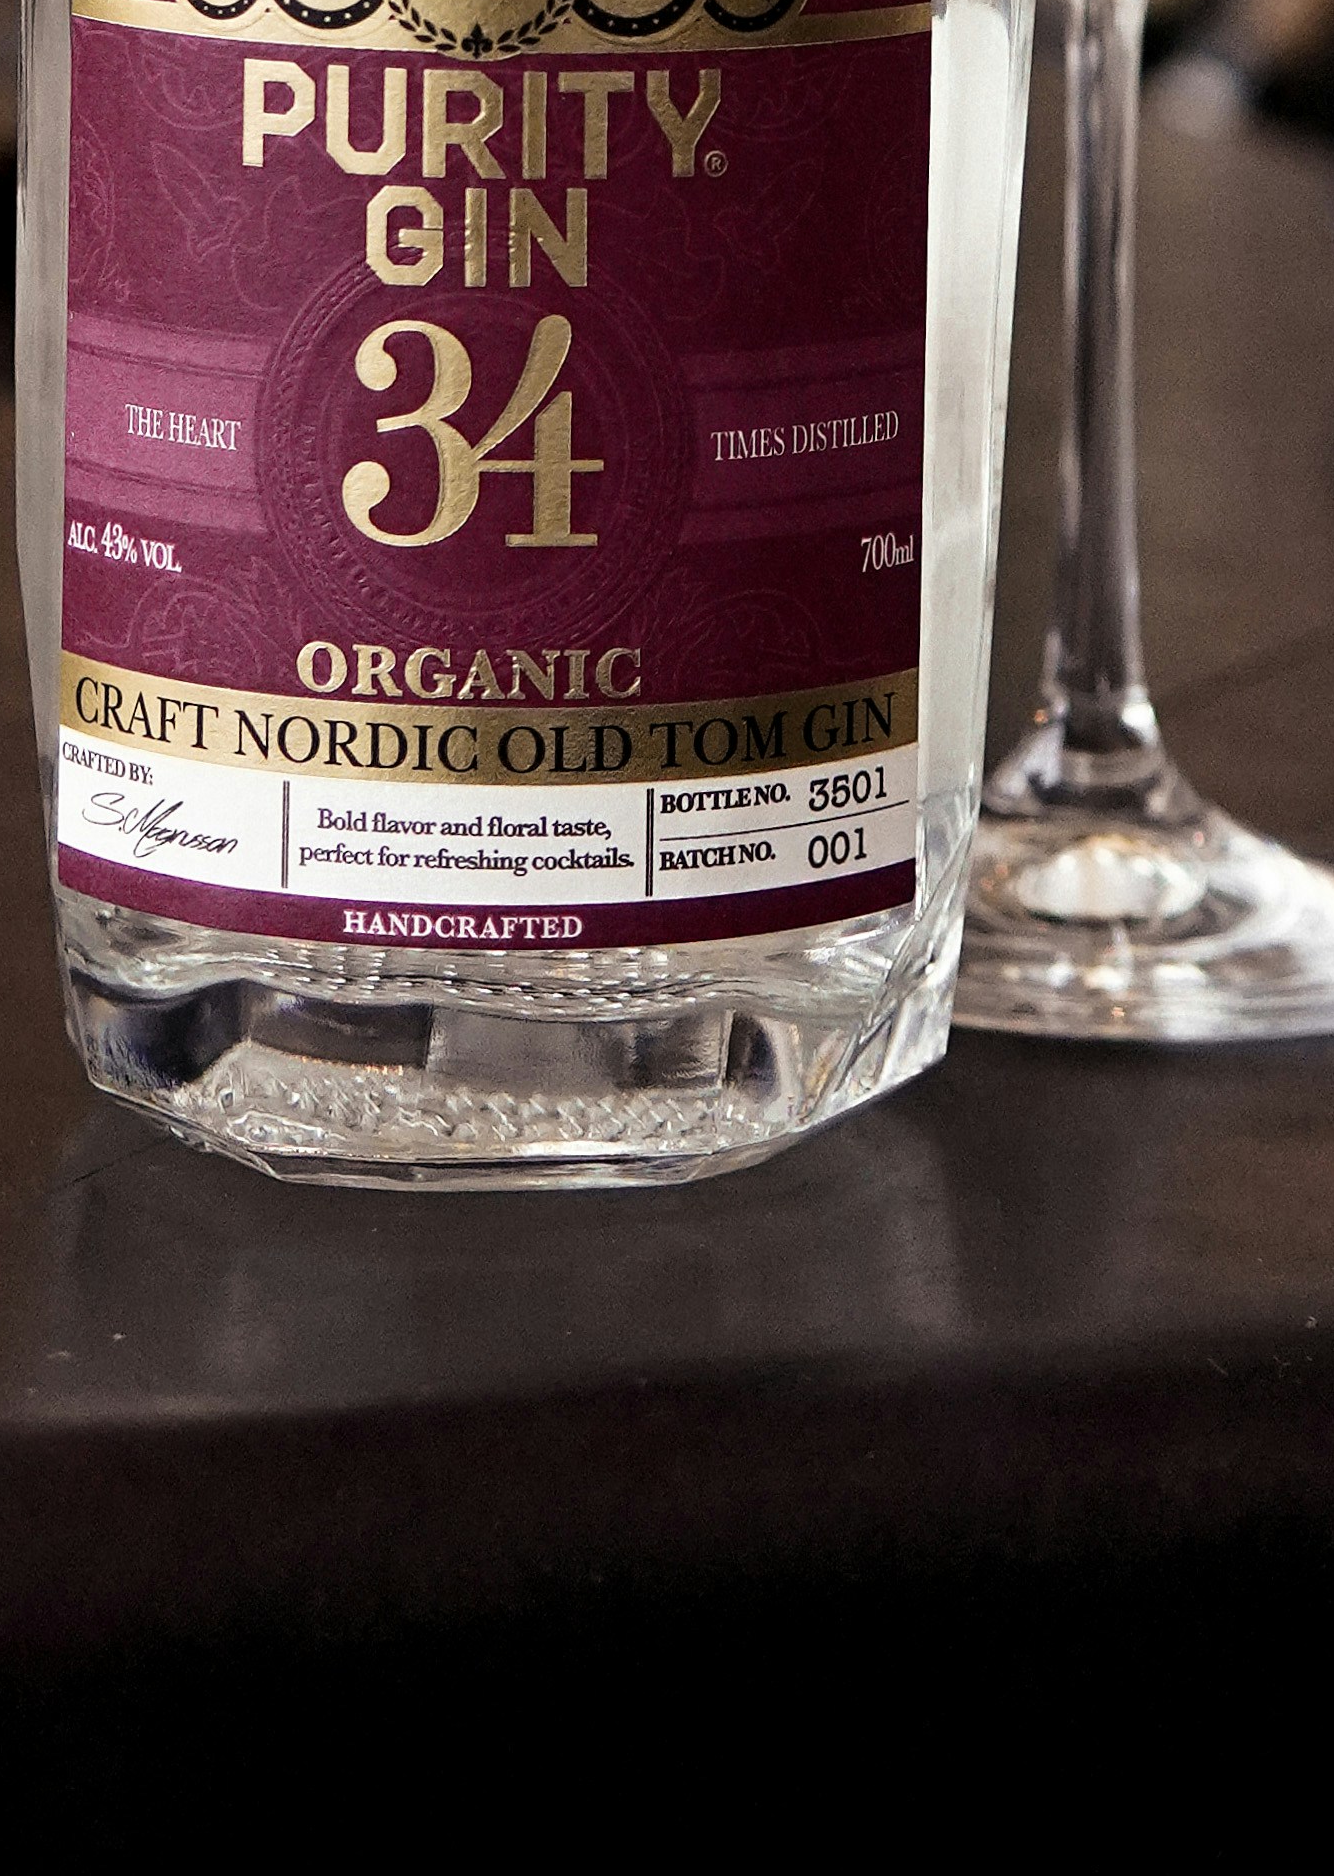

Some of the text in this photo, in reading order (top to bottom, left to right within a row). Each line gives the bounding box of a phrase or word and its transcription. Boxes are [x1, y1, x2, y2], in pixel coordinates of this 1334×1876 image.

[365, 185, 589, 288] GIN
[125, 404, 242, 450] THE HEART
[342, 314, 604, 547] 34
[711, 410, 899, 461] TIMES DISTILLED
[68, 520, 98, 554] ALC.
[101, 521, 138, 564] 43%
[860, 533, 914, 573] 700ml
[296, 640, 641, 701] ORGANIC
[75, 676, 897, 774] CRAFT NORDIC OLD TOM GIN
[62, 742, 154, 786] CRAFTED BY:
[660, 766, 887, 814] BOTTLE NO. 3501
[317, 808, 611, 840] Bold flavor and floral taste,
[299, 843, 634, 876] perfect for refreshing cocktails.
[659, 827, 867, 871] BATCH NO. 001
[342, 909, 583, 939] HANDCRAFTED
